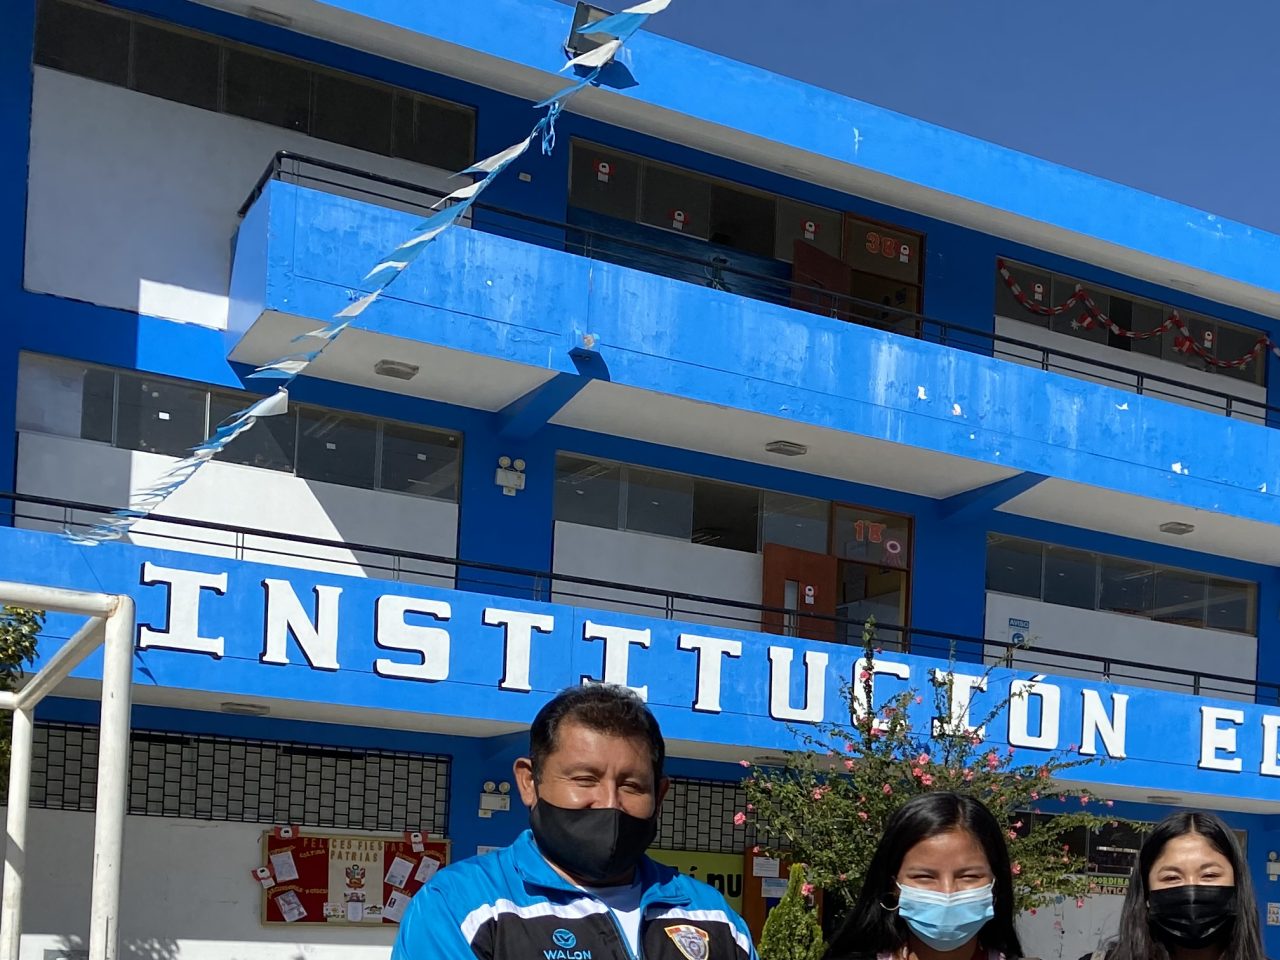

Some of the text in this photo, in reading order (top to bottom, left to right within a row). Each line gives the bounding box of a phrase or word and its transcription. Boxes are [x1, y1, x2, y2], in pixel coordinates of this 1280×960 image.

[138, 561, 1130, 759] INSTITUCIÓN
[331, 850, 378, 862] PATRIAS
[543, 949, 593, 960] WALON
